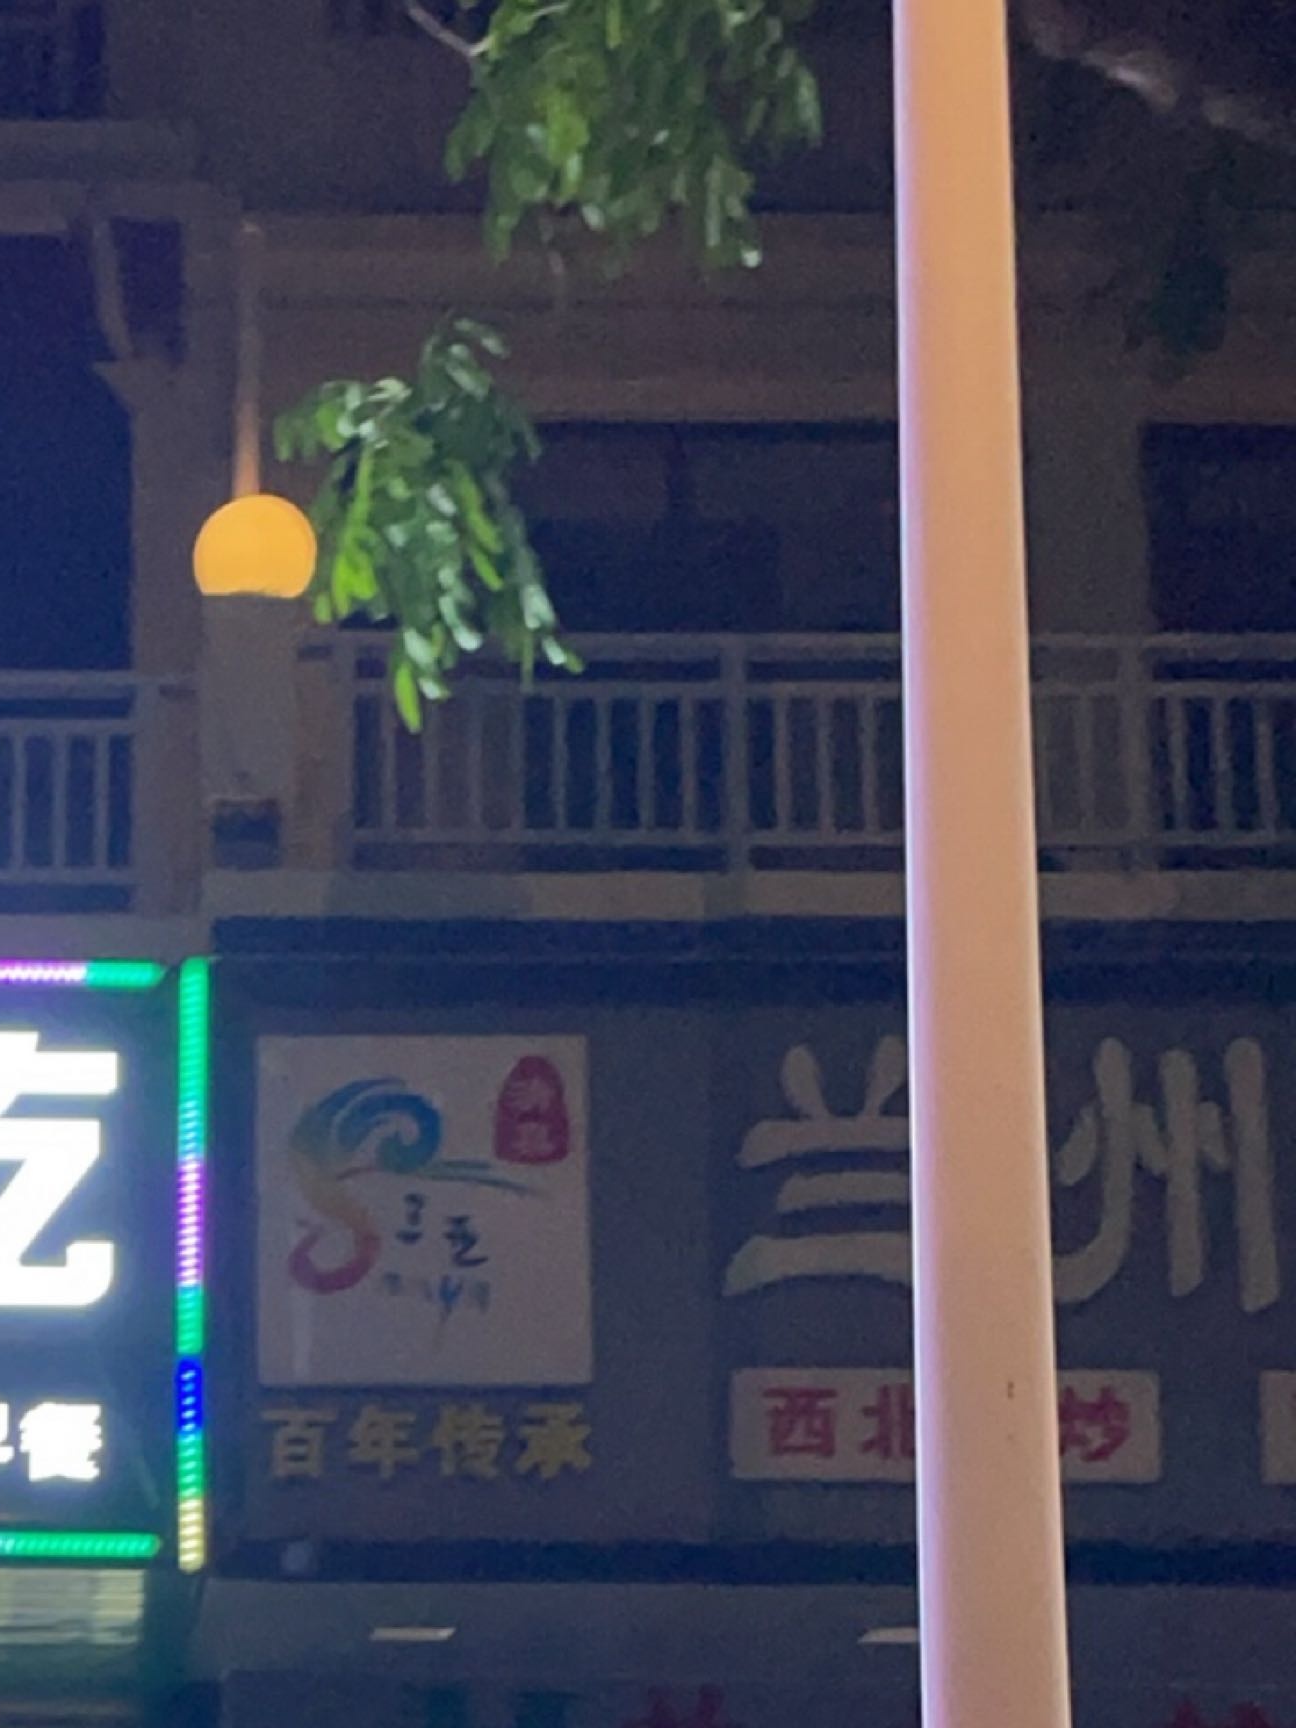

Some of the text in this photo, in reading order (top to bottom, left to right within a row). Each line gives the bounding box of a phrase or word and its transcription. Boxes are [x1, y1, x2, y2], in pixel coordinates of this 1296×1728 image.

[263, 1402, 593, 1481] 百年传承
[764, 1386, 1132, 1465] 西北炒
